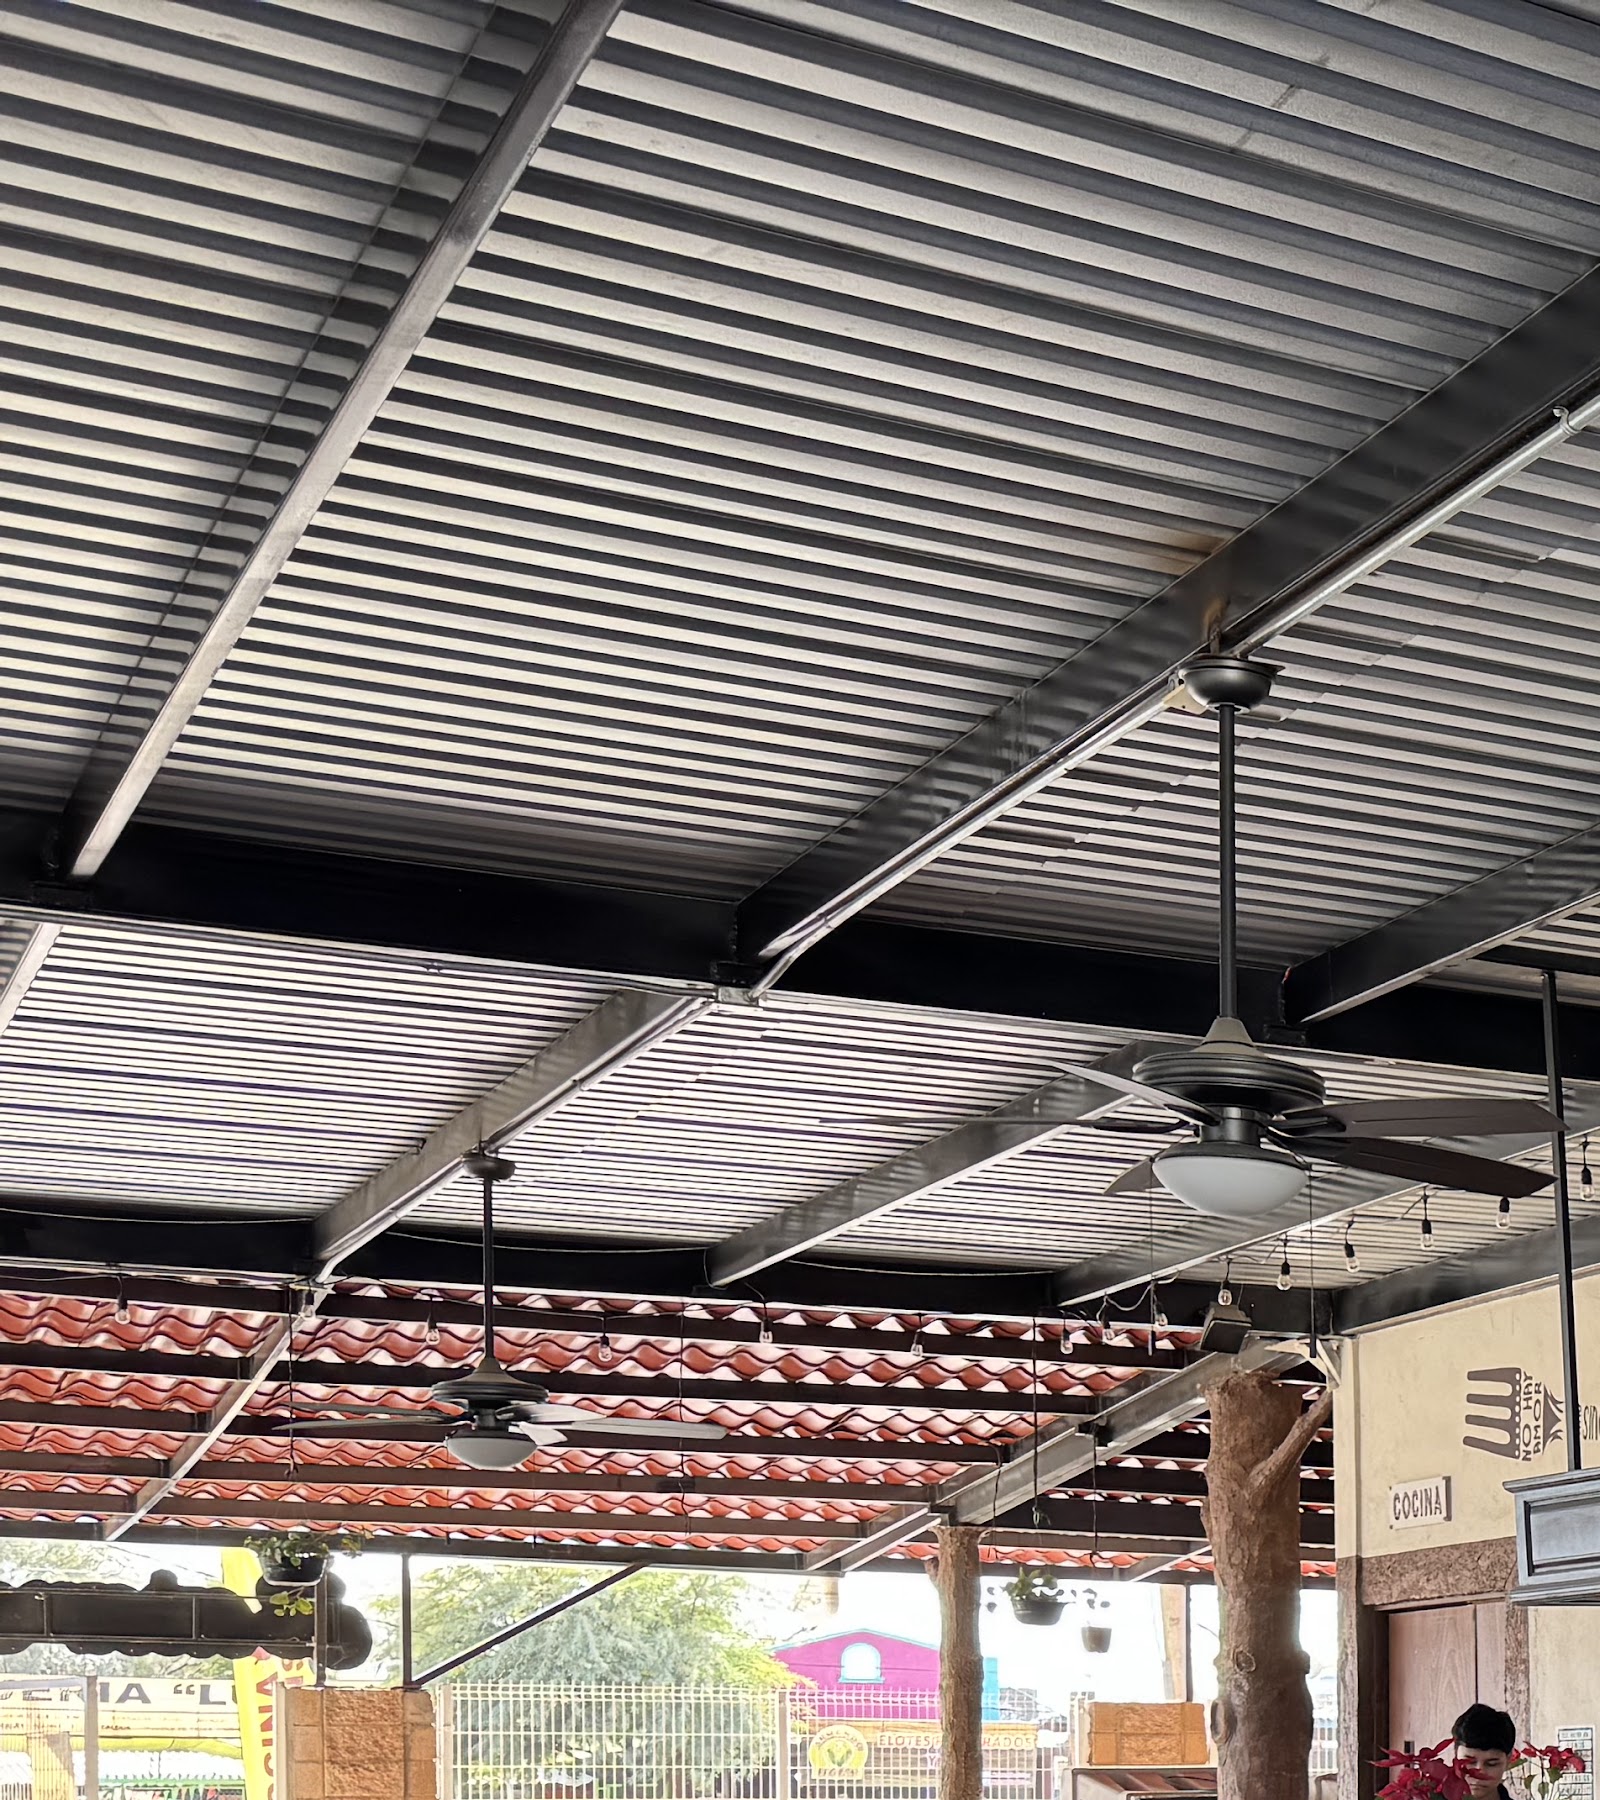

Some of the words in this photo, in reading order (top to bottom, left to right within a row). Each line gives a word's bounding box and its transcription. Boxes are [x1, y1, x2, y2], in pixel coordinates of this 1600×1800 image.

[1523, 1371, 1534, 1410] HAY
[1533, 1382, 1542, 1455] AMOR
[1522, 1424, 1532, 1461] NO
[1393, 1486, 1442, 1520] COCINA
